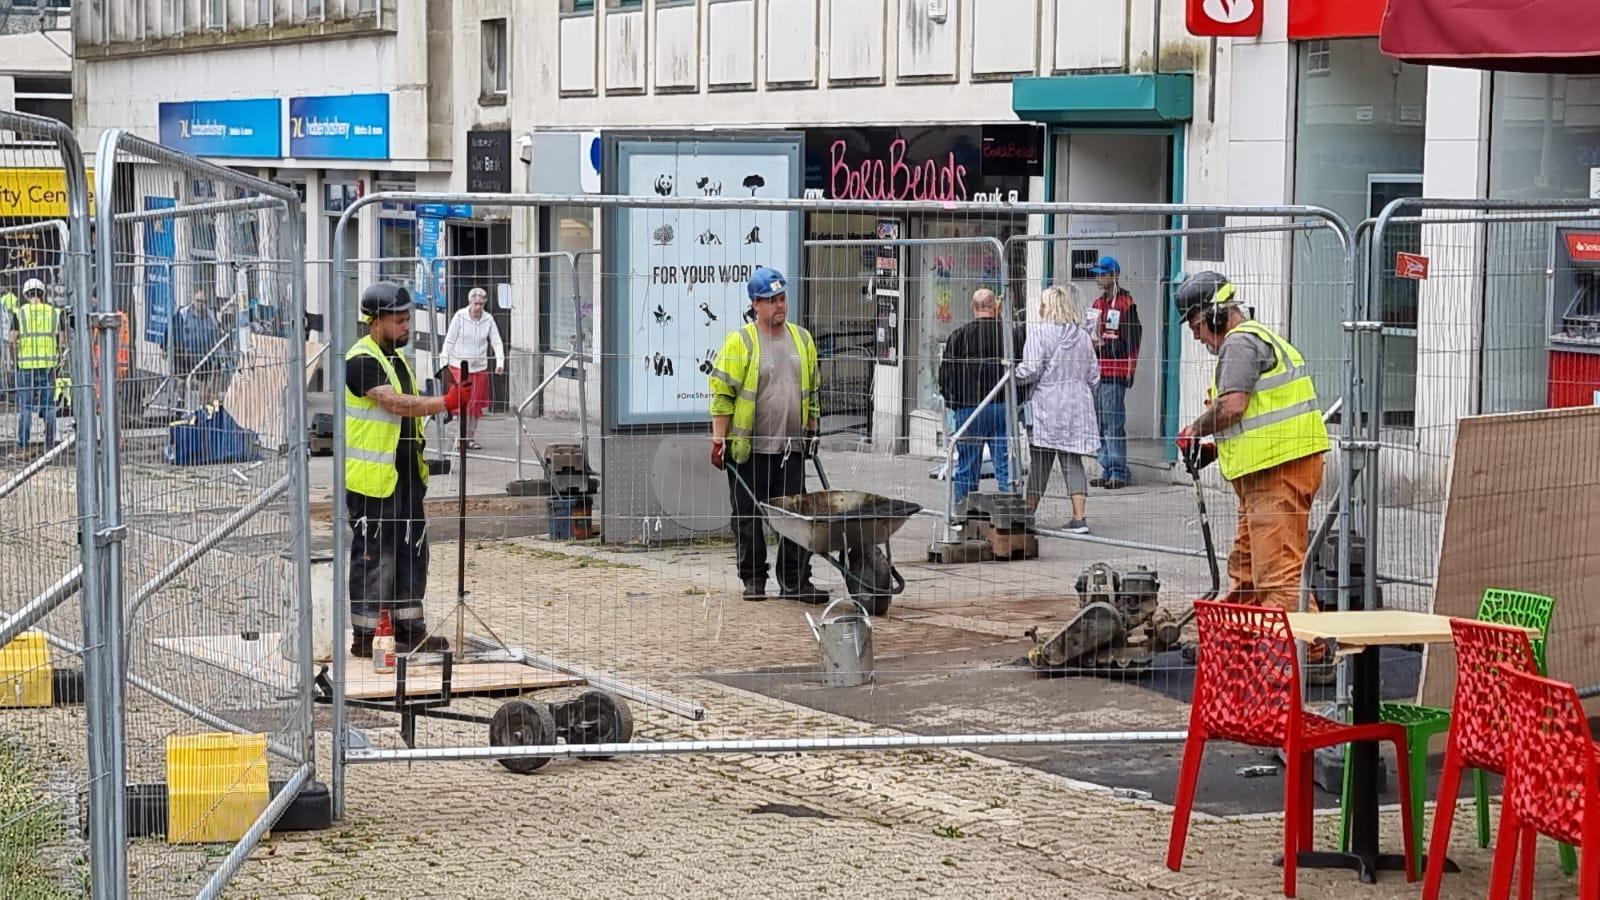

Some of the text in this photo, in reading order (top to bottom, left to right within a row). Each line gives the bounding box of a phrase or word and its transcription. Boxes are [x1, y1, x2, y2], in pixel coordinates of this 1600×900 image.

[28, 185, 94, 204] Cene
[653, 265, 763, 284] FOR YOUR WORL
